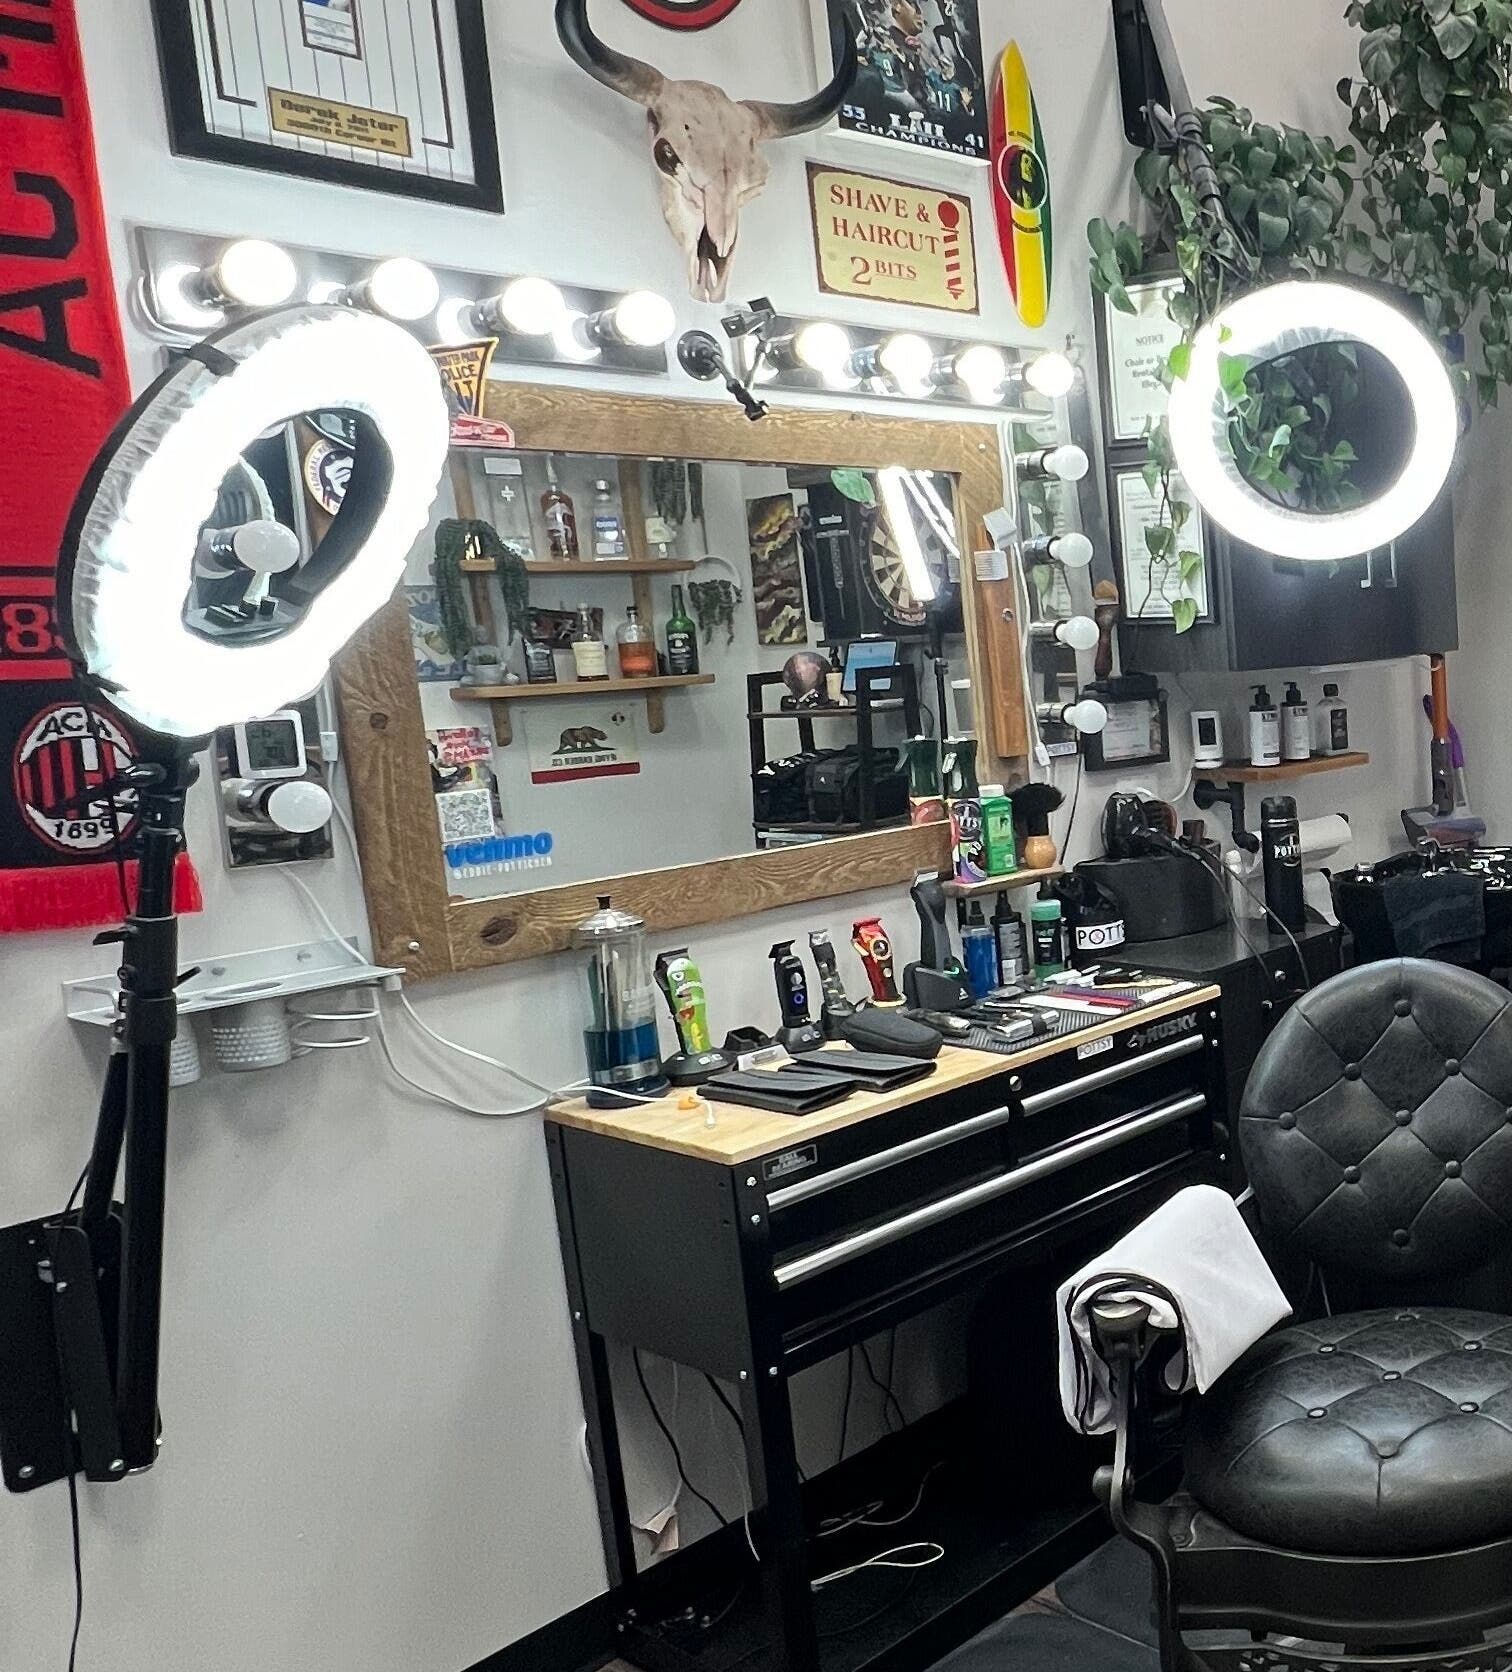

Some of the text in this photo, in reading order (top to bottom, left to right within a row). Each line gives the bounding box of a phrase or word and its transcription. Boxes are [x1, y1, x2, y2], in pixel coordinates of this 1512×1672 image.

[855, 121, 977, 156] CHAMPIONS
[965, 133, 984, 149] 41
[830, 184, 931, 224] SHAVE &
[833, 216, 940, 255] HAIRCUT
[850, 256, 917, 285] 2 BITS
[1135, 334, 1164, 346] NOTICE
[440, 364, 478, 379] OLICE
[447, 832, 552, 868] venmo
[1078, 924, 1122, 945] POTT
[1147, 1012, 1197, 1043] HUSKY
[1078, 1036, 1112, 1056] POTTSY
